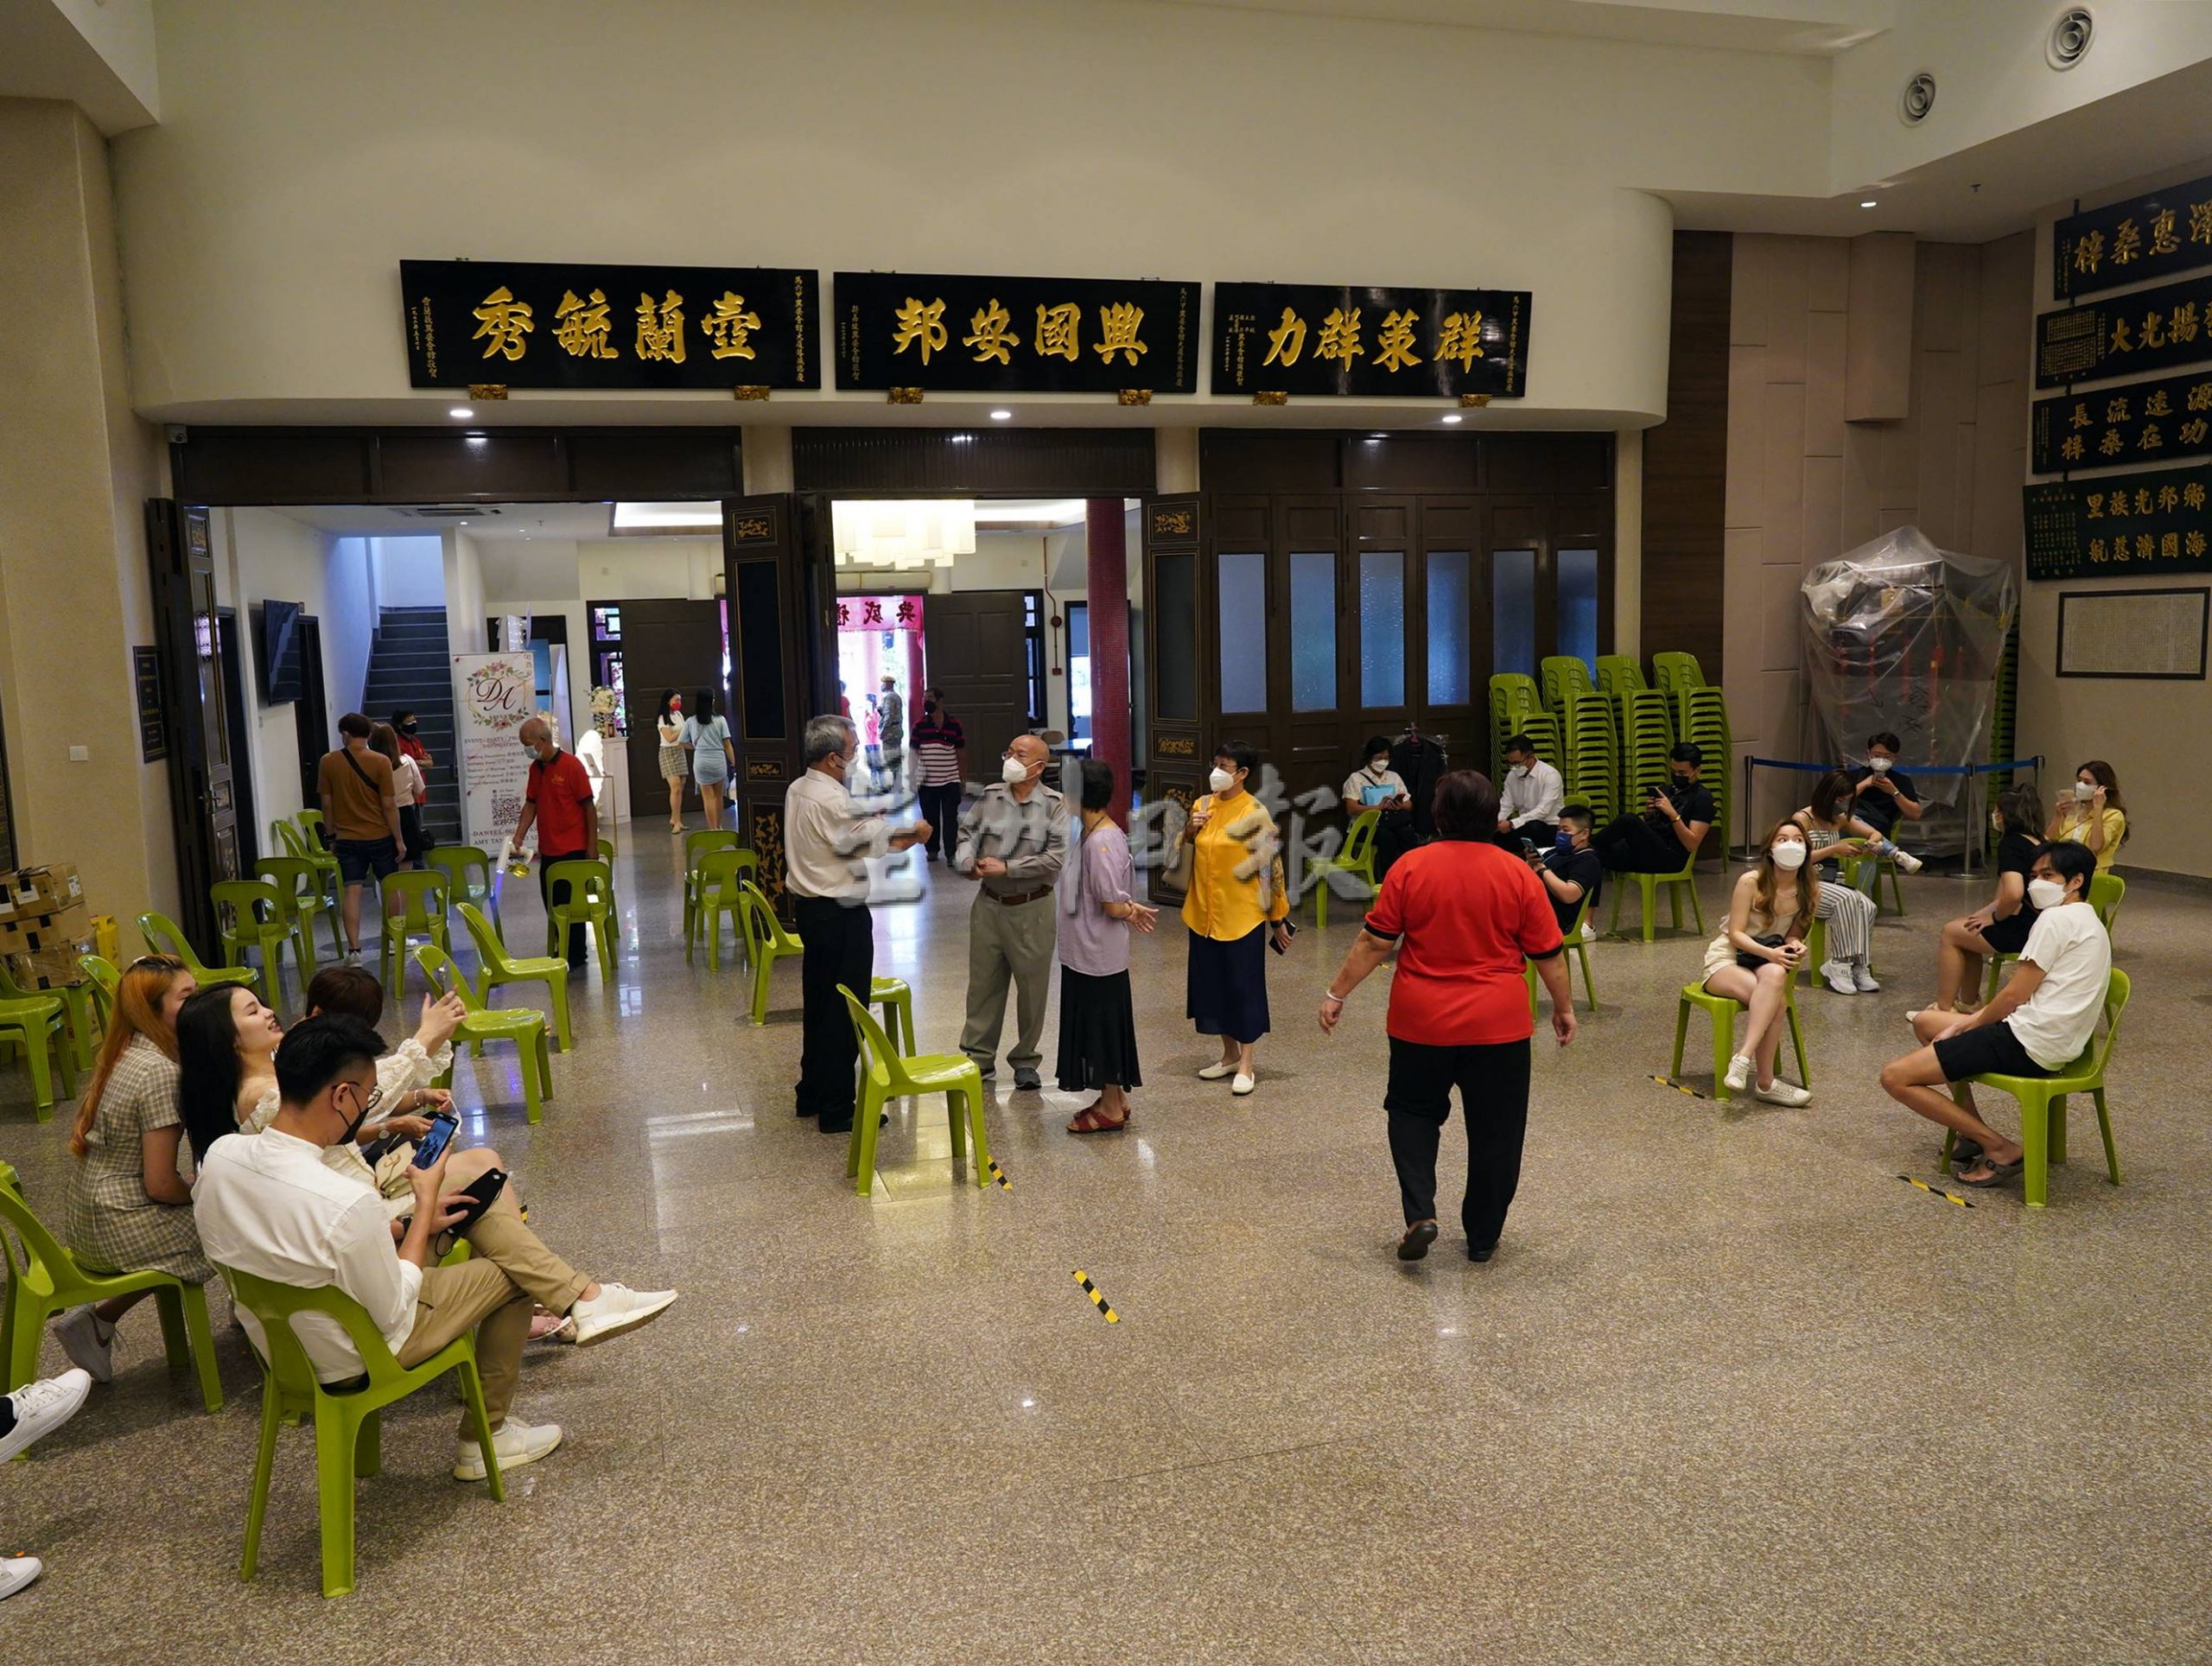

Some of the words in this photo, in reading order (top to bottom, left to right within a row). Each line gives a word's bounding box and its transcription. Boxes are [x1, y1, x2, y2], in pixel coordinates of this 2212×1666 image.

[893, 296, 1148, 366] 興國安邦
[1263, 307, 1484, 373] 群策群力
[2062, 417, 2209, 461] 功在桑梓
[476, 677, 516, 711] DA
[473, 829, 503, 837] DANIEL
